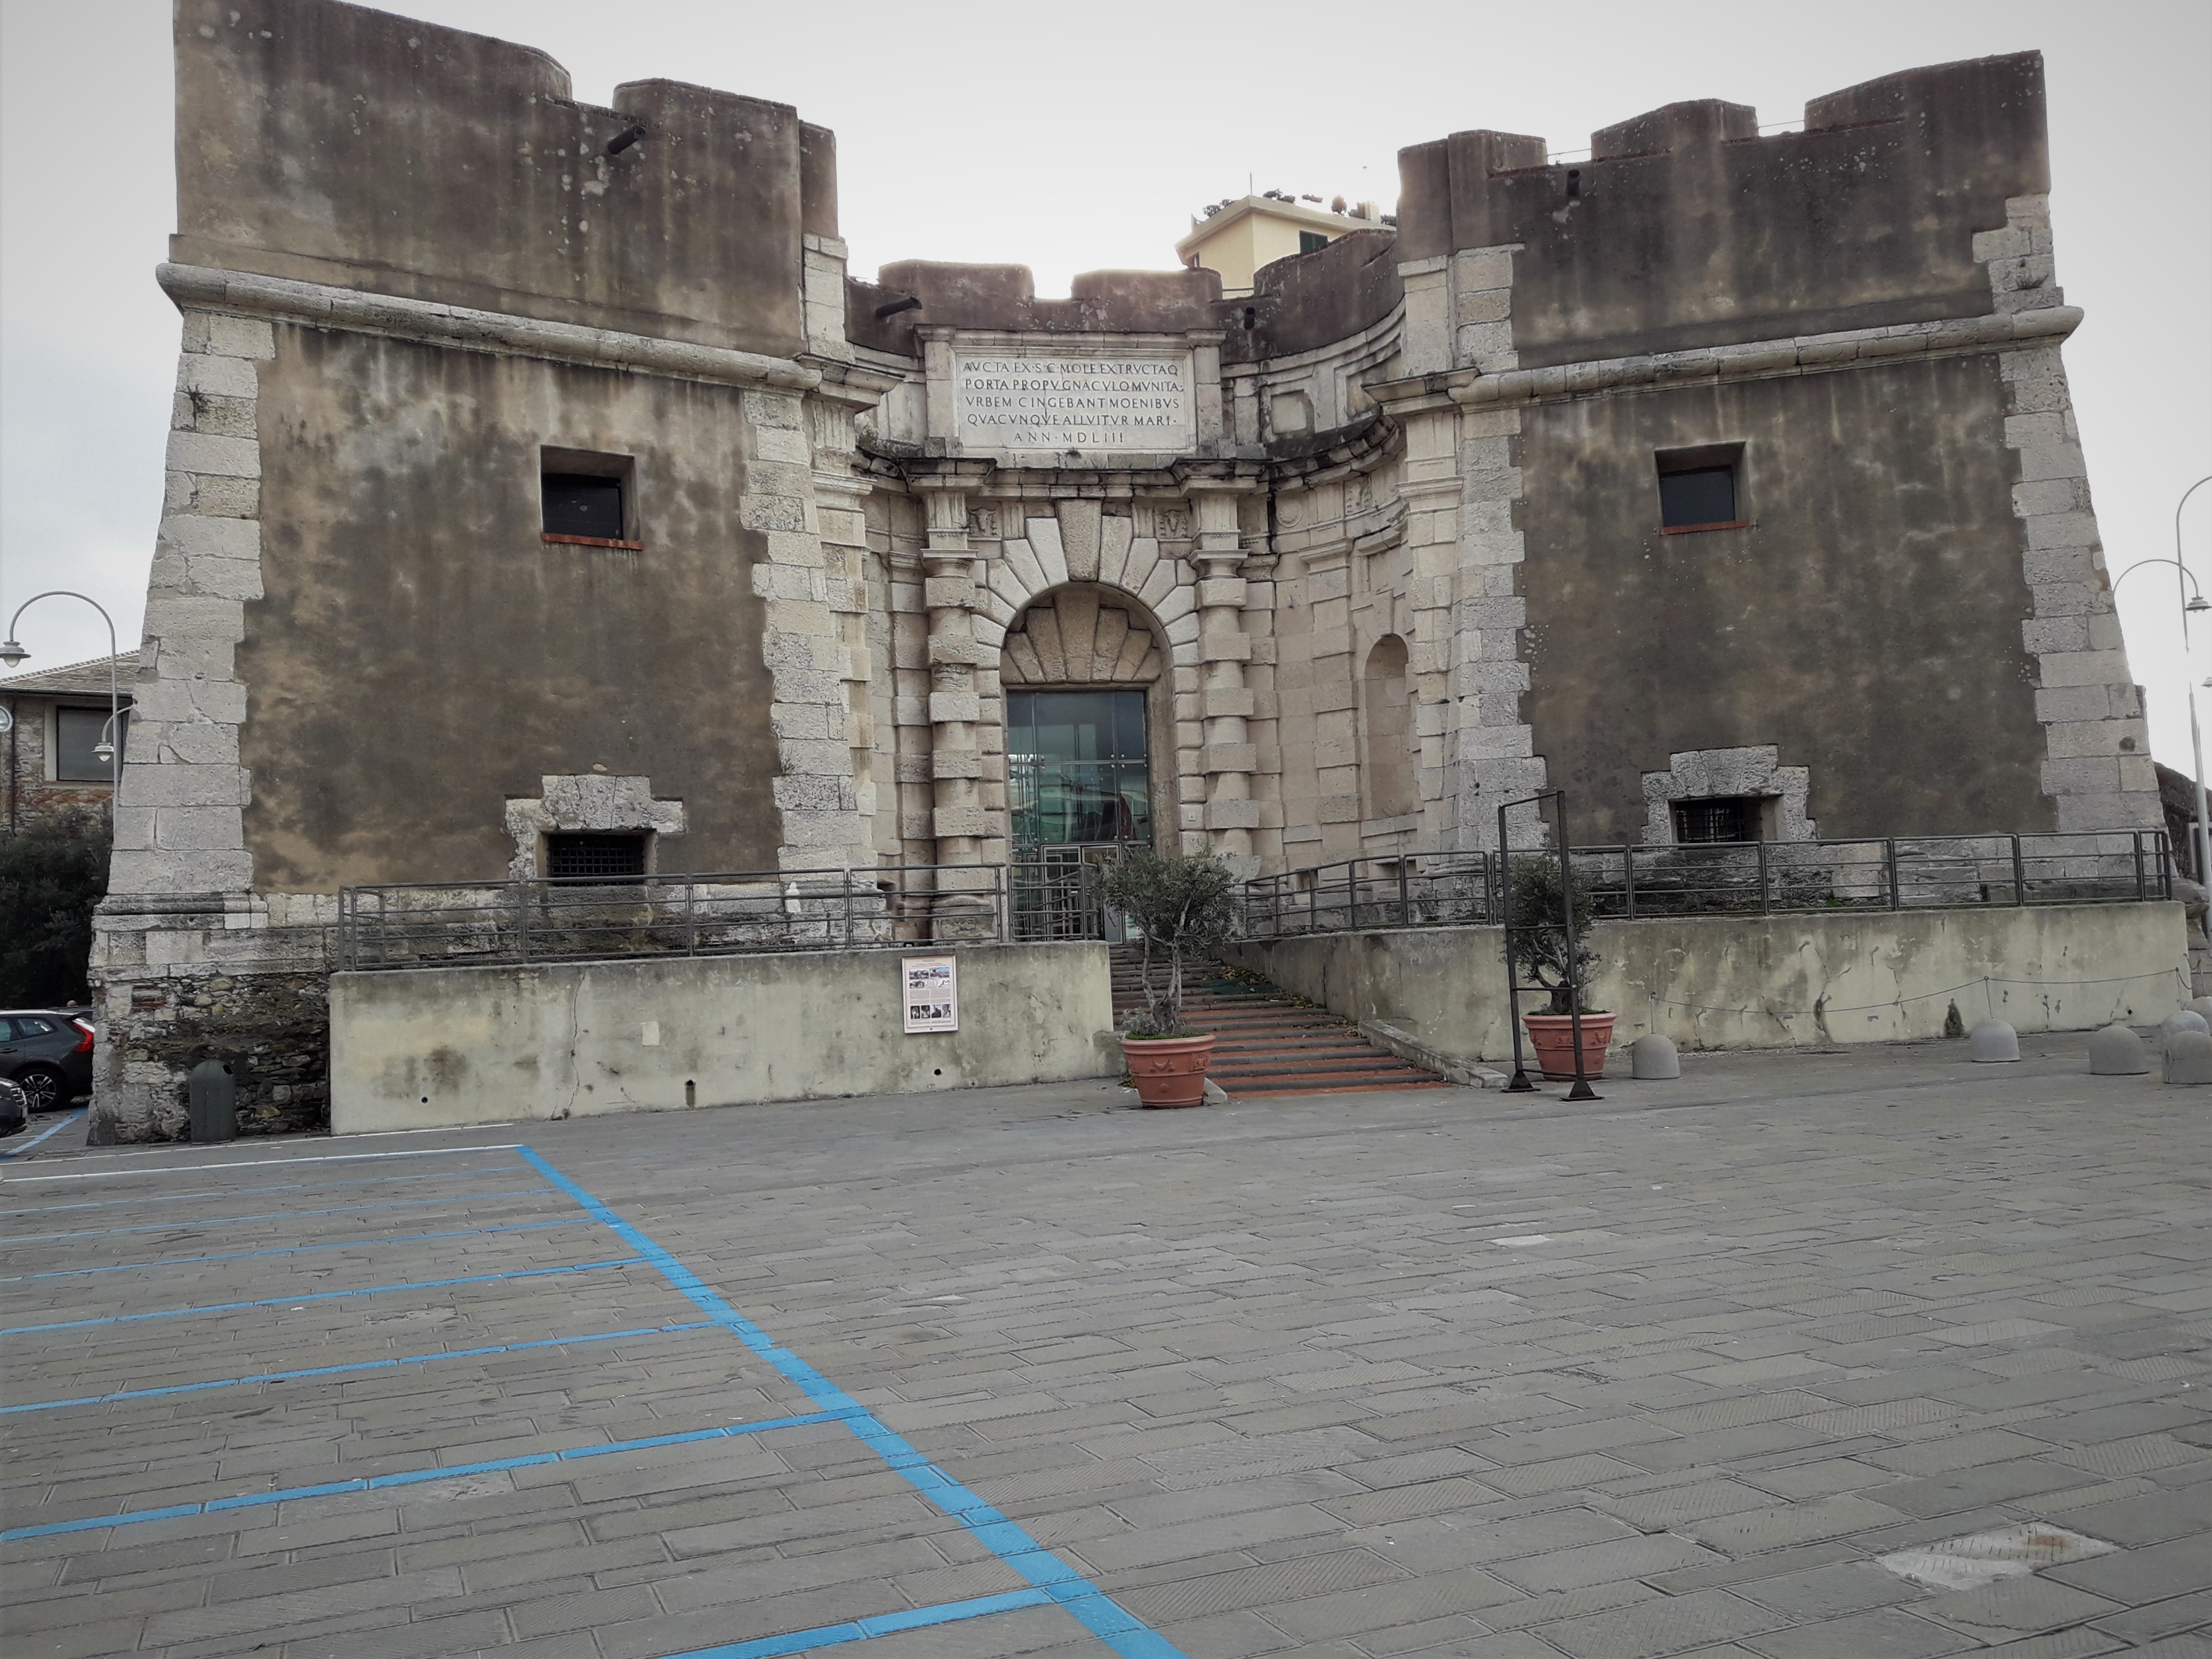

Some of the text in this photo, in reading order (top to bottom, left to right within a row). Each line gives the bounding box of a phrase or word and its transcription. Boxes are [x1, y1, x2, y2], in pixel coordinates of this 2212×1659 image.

[963, 362, 1010, 373] AVCTA
[1100, 364, 1178, 377] EXTRVCTAQ
[965, 379, 1009, 390] PORTA
[1013, 379, 1129, 392] PROPVGNACVLO
[966, 396, 1179, 409] VRBEM CINGEBANT MOENIBVS
[968, 414, 1059, 427] QVACVNQVE
[1063, 415, 1128, 426] ALLVITVR
